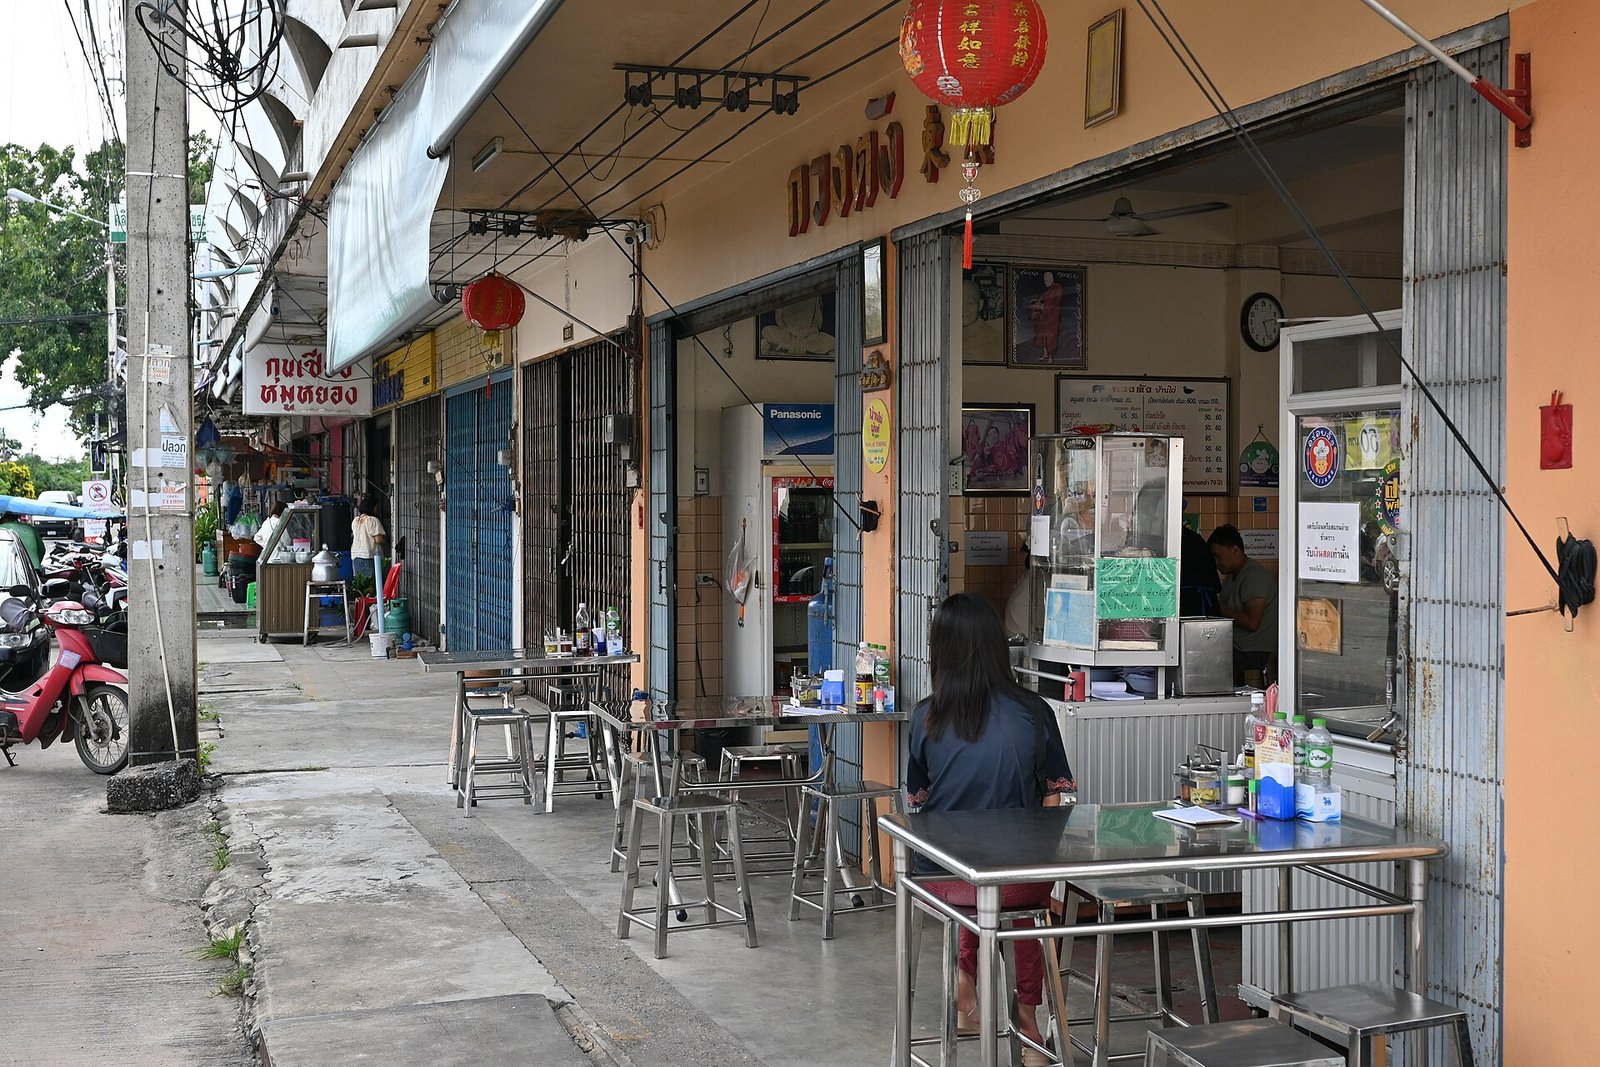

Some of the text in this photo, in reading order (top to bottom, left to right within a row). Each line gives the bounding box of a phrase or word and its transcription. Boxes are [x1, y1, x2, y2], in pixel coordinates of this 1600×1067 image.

[266, 348, 353, 384] กุนเชีง
[260, 384, 358, 412] หมูหยอง
[770, 409, 822, 419] Panasonic
[162, 440, 186, 453] ปลวก
[1306, 545, 1350, 559] รับเงินสดเท่านั้น
